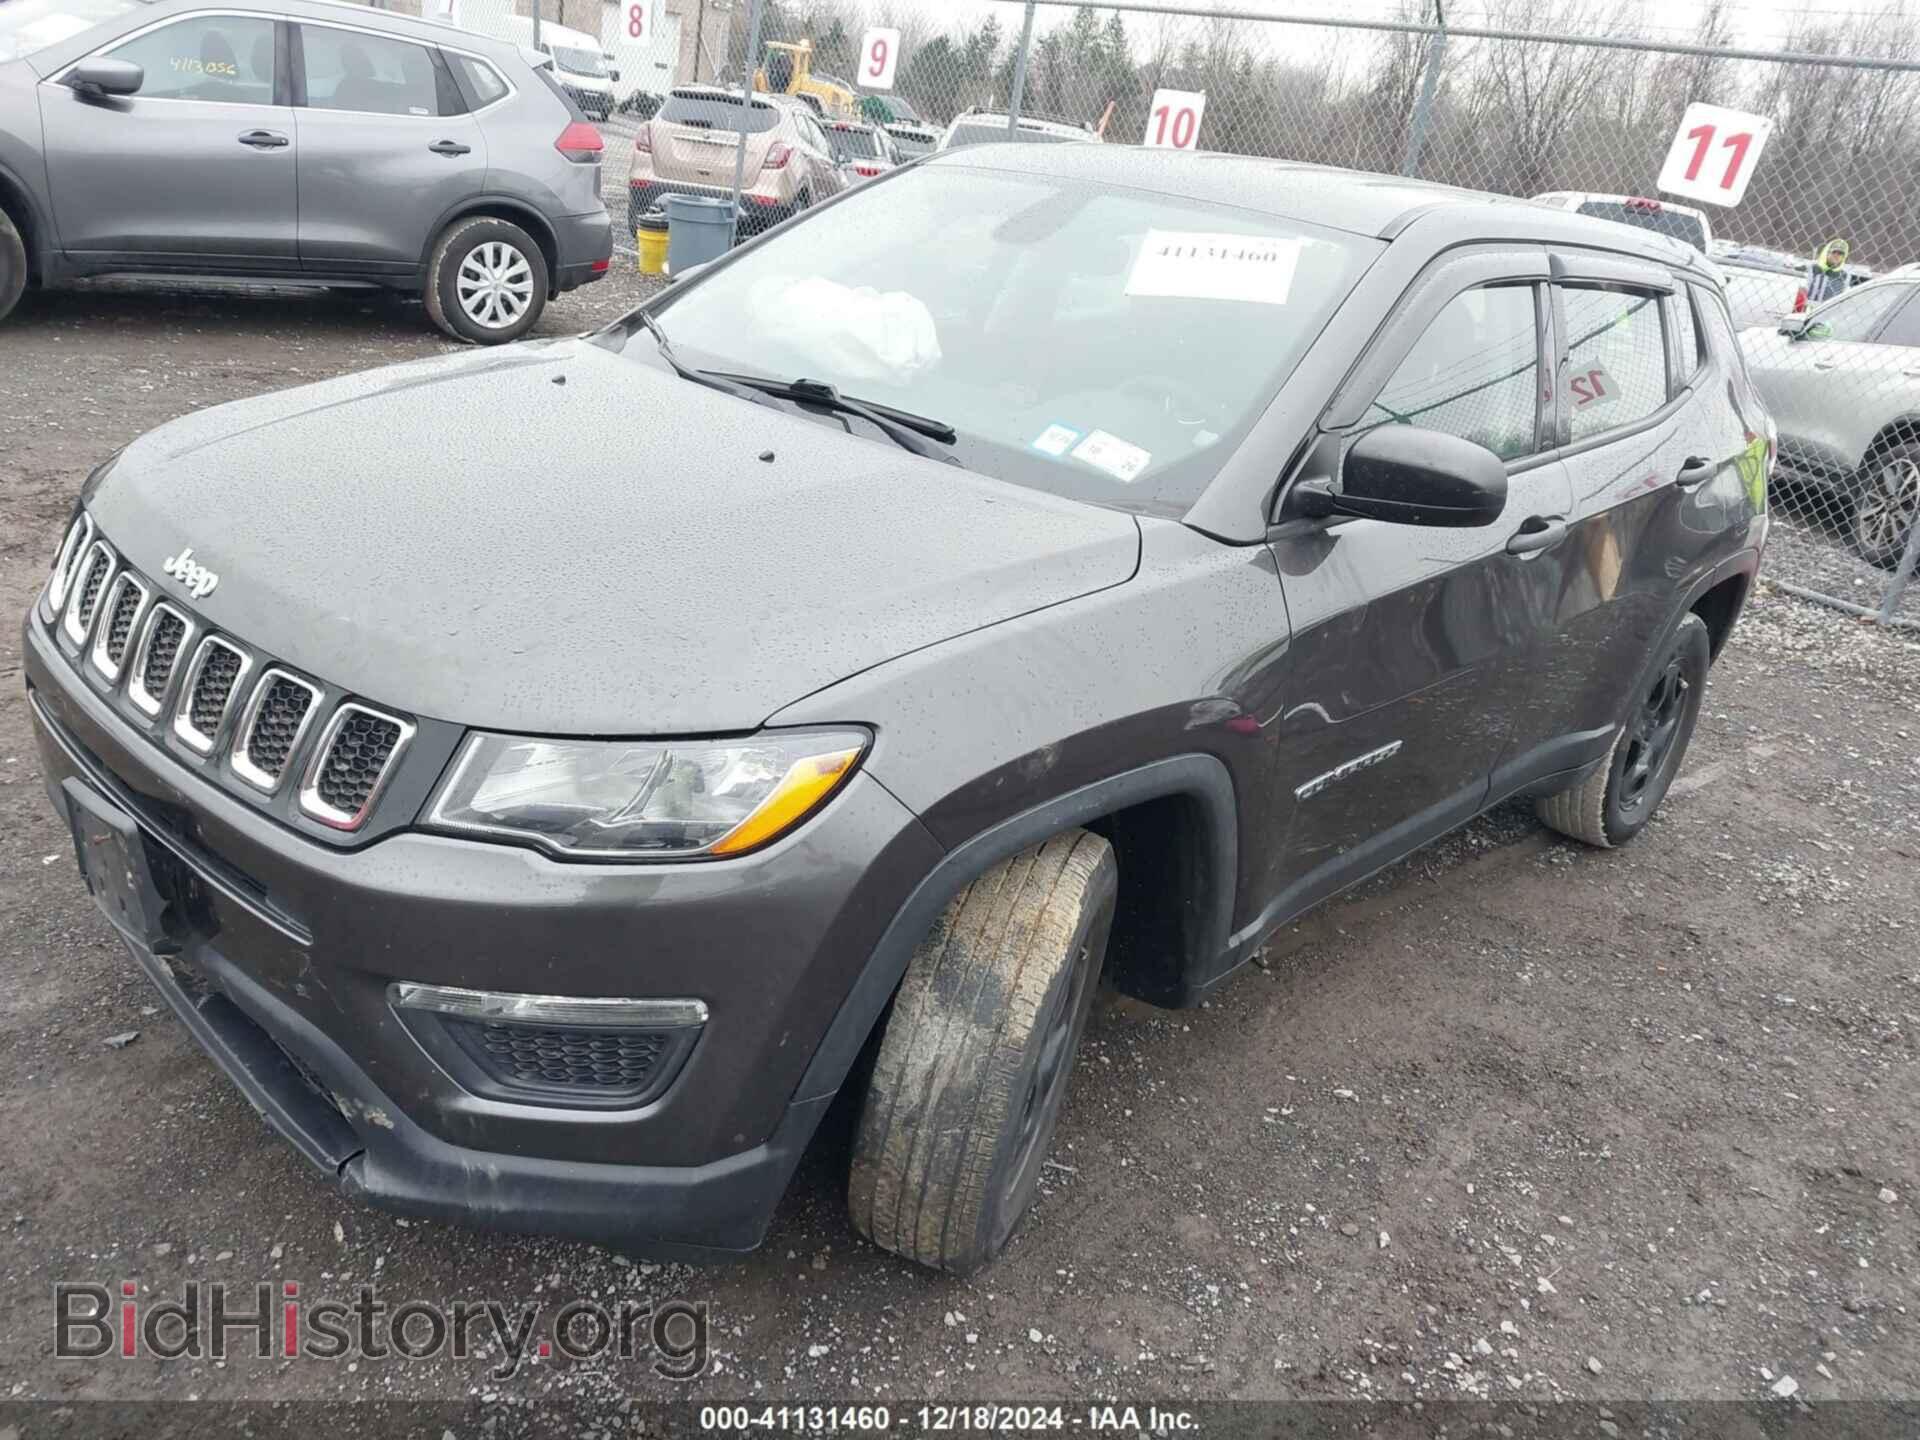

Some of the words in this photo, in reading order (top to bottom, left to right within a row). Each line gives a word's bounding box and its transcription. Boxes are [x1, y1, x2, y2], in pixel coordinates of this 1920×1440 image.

[629, 4, 643, 37] 8
[870, 39, 887, 77] 9
[1154, 105, 1196, 148] 10
[1684, 124, 1752, 190] 11
[163, 547, 219, 599] Jeep
